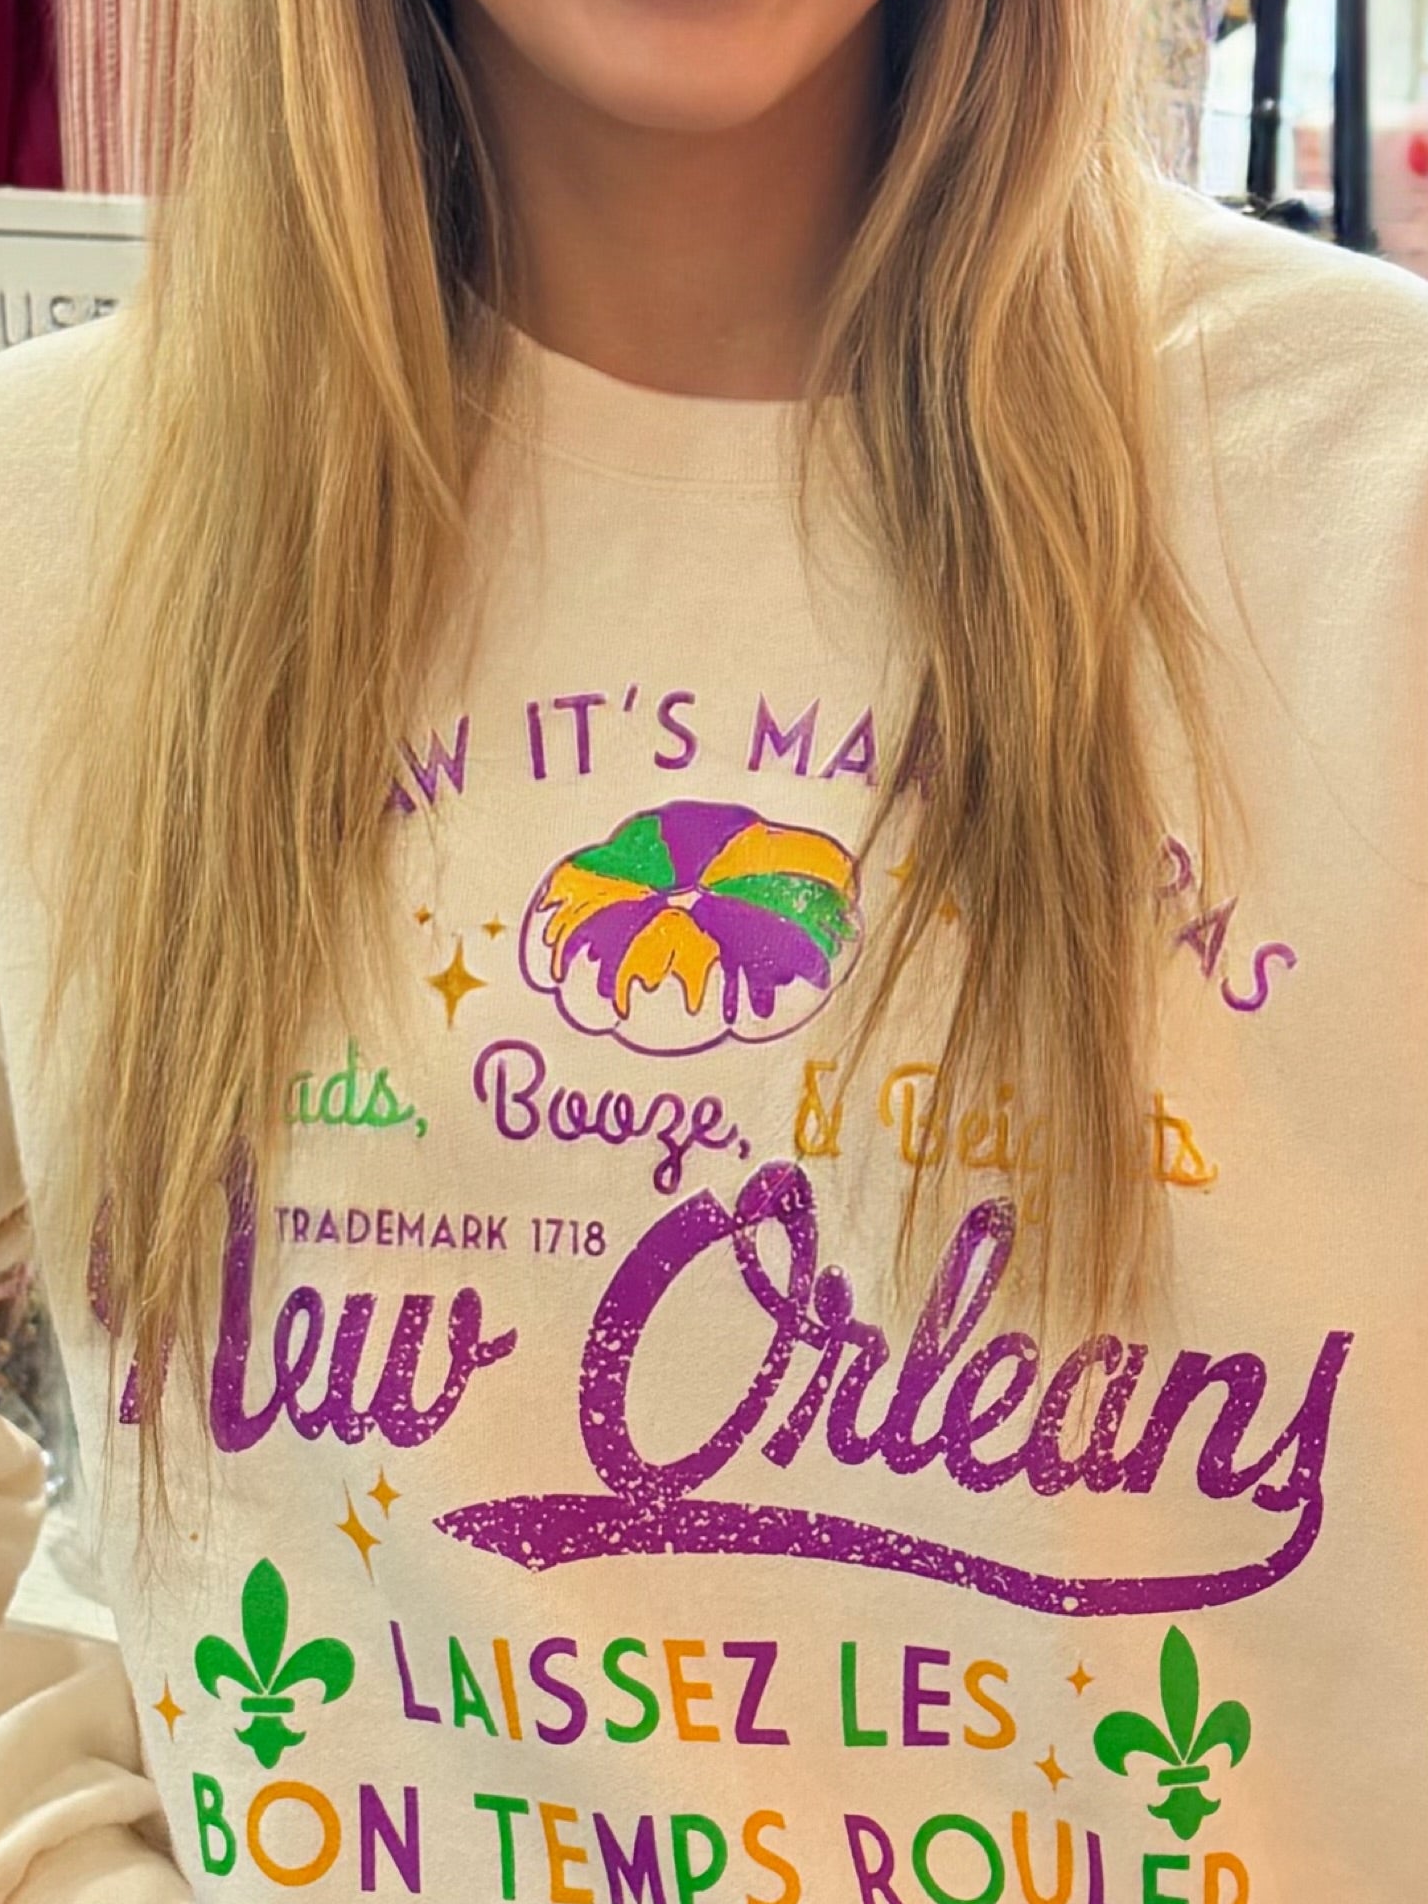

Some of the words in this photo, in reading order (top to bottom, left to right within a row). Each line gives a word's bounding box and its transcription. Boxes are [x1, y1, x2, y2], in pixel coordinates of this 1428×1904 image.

[526, 684, 697, 782] IT'S
[473, 1039, 750, 1195] Booze,
[275, 1205, 509, 1252] TRADEMARK
[530, 1216, 608, 1259] 1718
[579, 1158, 1355, 1514] Orleans
[390, 1619, 791, 1748] LAISSEZ
[839, 1639, 1018, 1751] LES
[194, 1772, 423, 1894] BON
